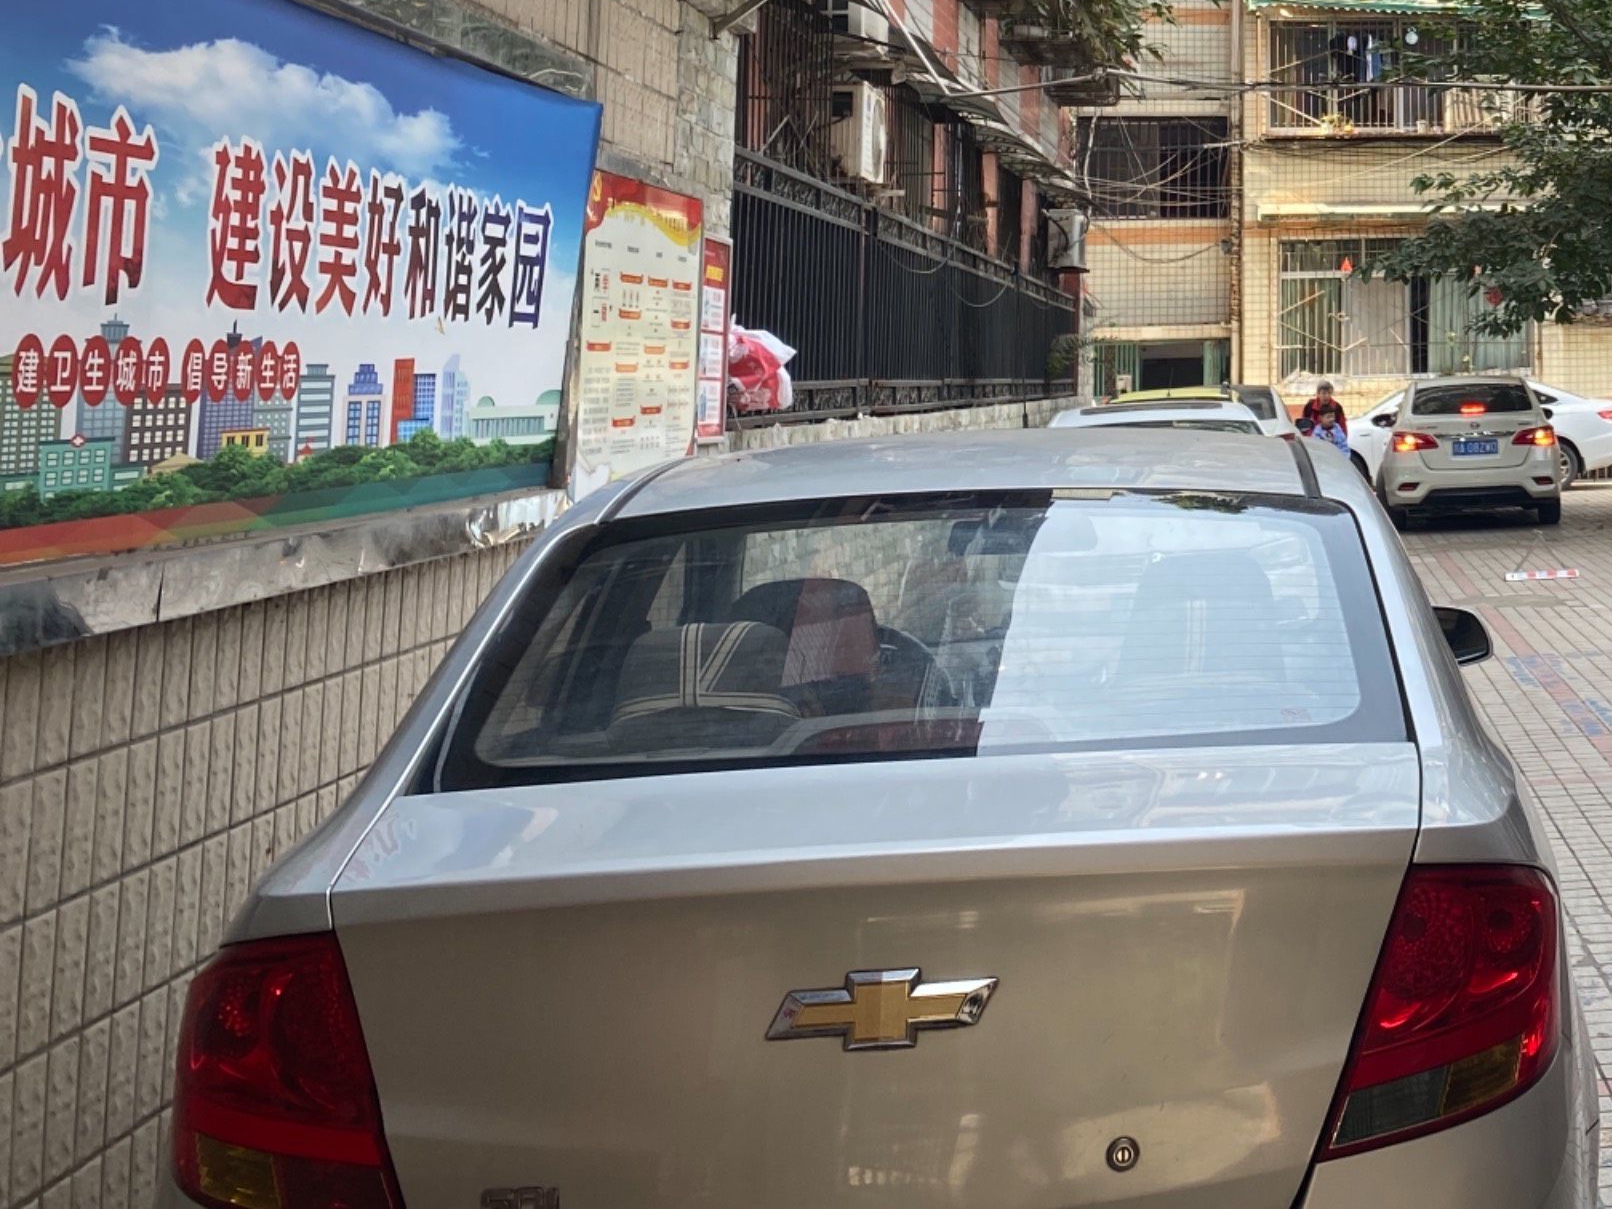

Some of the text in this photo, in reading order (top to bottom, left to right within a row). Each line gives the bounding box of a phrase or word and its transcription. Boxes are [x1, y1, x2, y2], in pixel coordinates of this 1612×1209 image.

[4, 92, 552, 330] 城市 建设美好和谐家园
[16, 348, 299, 394] 建卫生城市 倡导新生活
